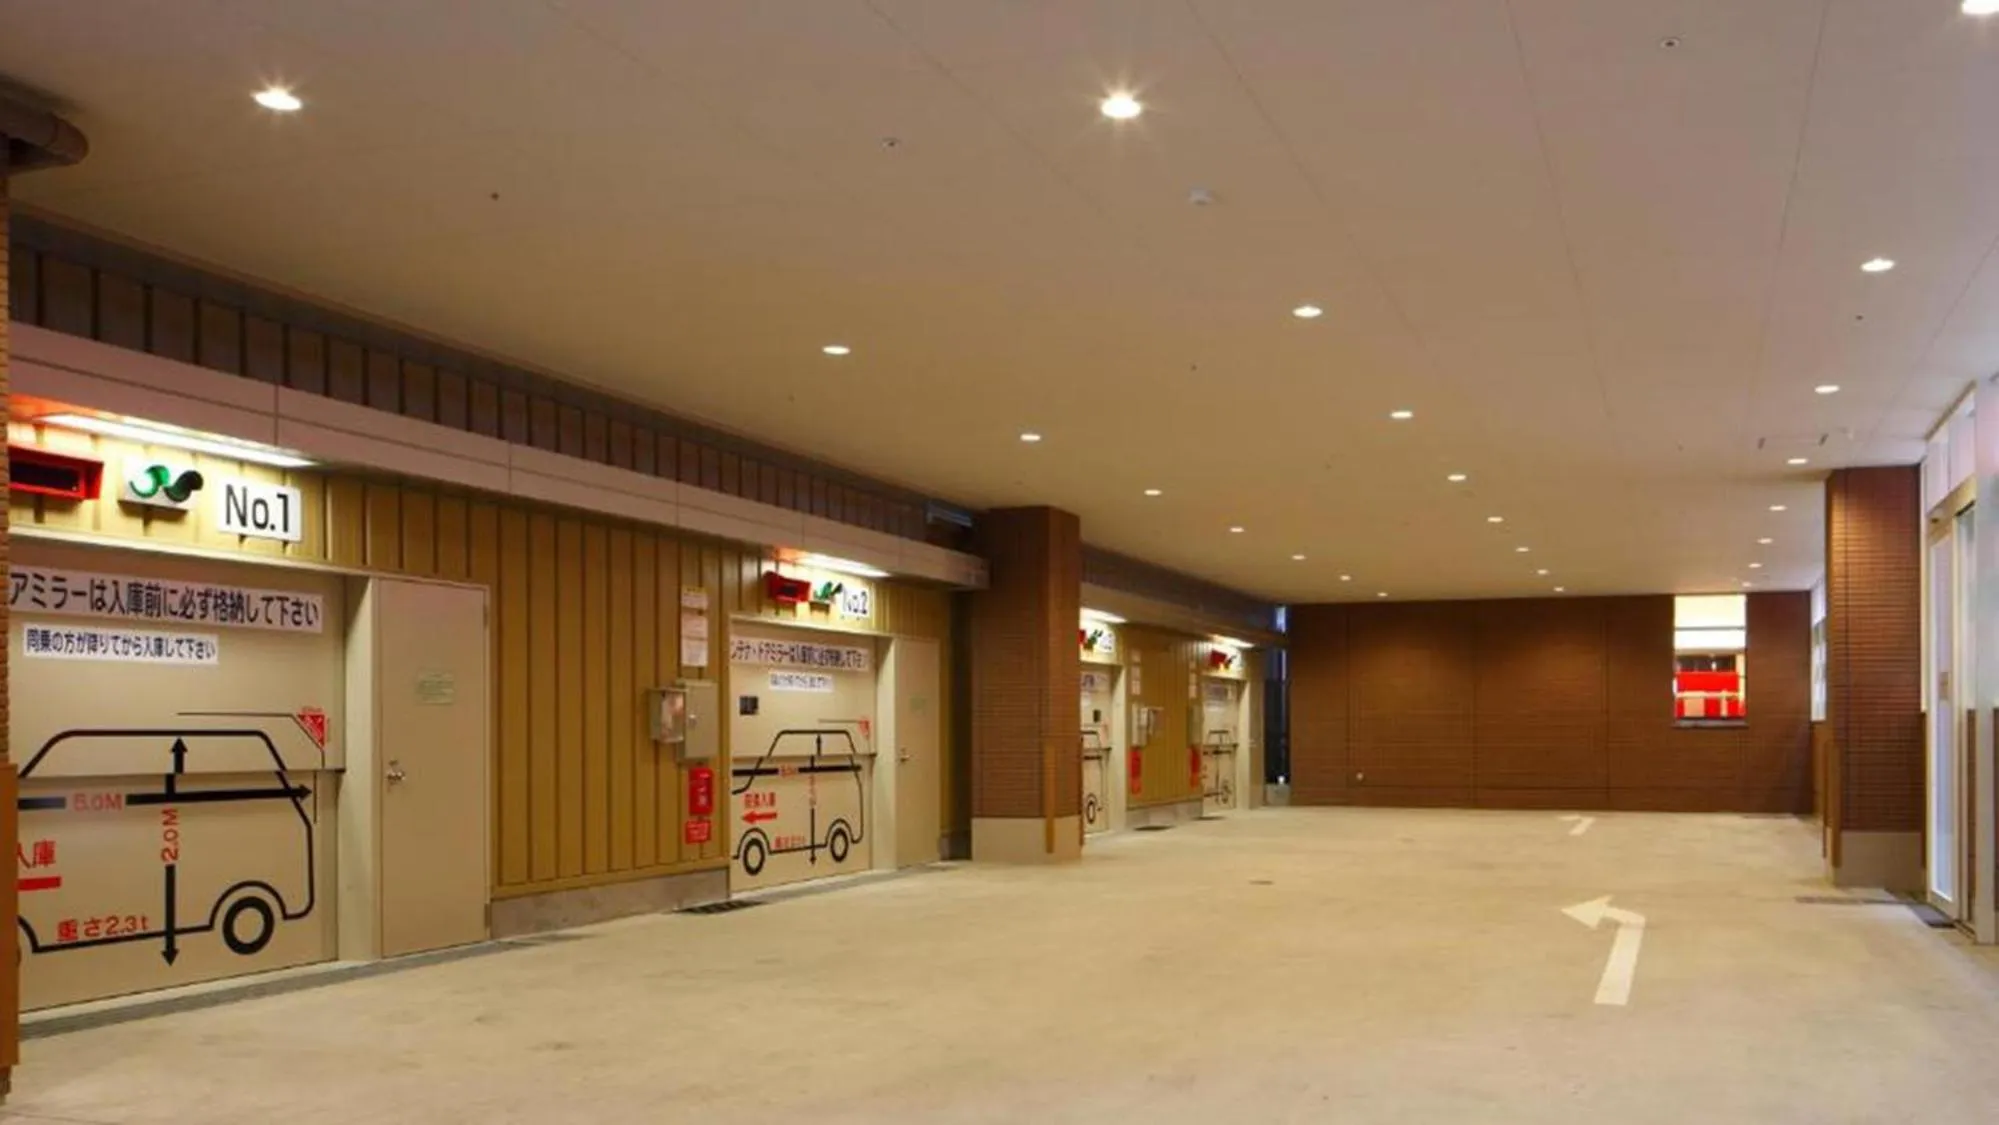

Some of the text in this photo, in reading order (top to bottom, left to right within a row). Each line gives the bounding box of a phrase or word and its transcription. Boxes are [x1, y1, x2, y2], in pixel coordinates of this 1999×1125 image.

[225, 484, 290, 533] No.1
[10, 572, 319, 627] アミラーは入庫前に必ず格納して下さい
[161, 809, 180, 862] 2.0M
[58, 915, 149, 942] 重さ2.3t
